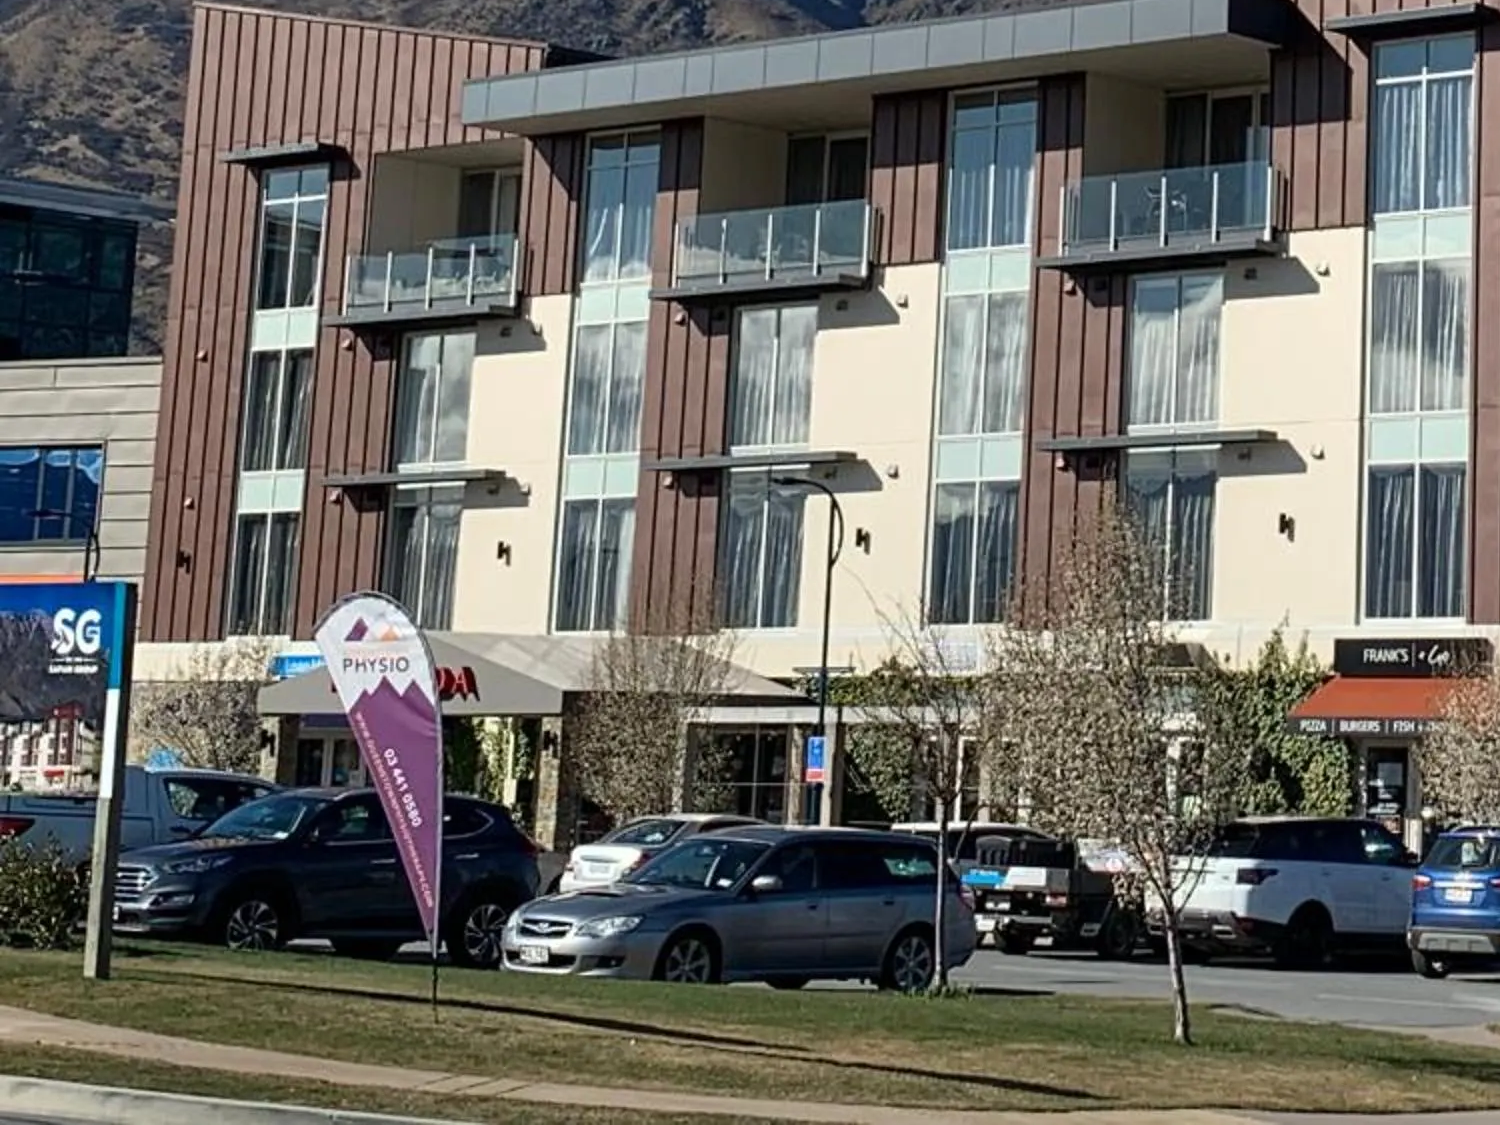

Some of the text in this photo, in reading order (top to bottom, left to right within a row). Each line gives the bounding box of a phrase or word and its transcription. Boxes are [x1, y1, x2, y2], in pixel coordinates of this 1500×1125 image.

[51, 607, 102, 654] SG
[343, 656, 410, 673] PHYSIO
[1300, 719, 1327, 732] PIZZA
[1339, 719, 1381, 732] BURGERS
[1393, 719, 1415, 732] FISH
[384, 748, 398, 766] 03
[393, 768, 409, 792] 441
